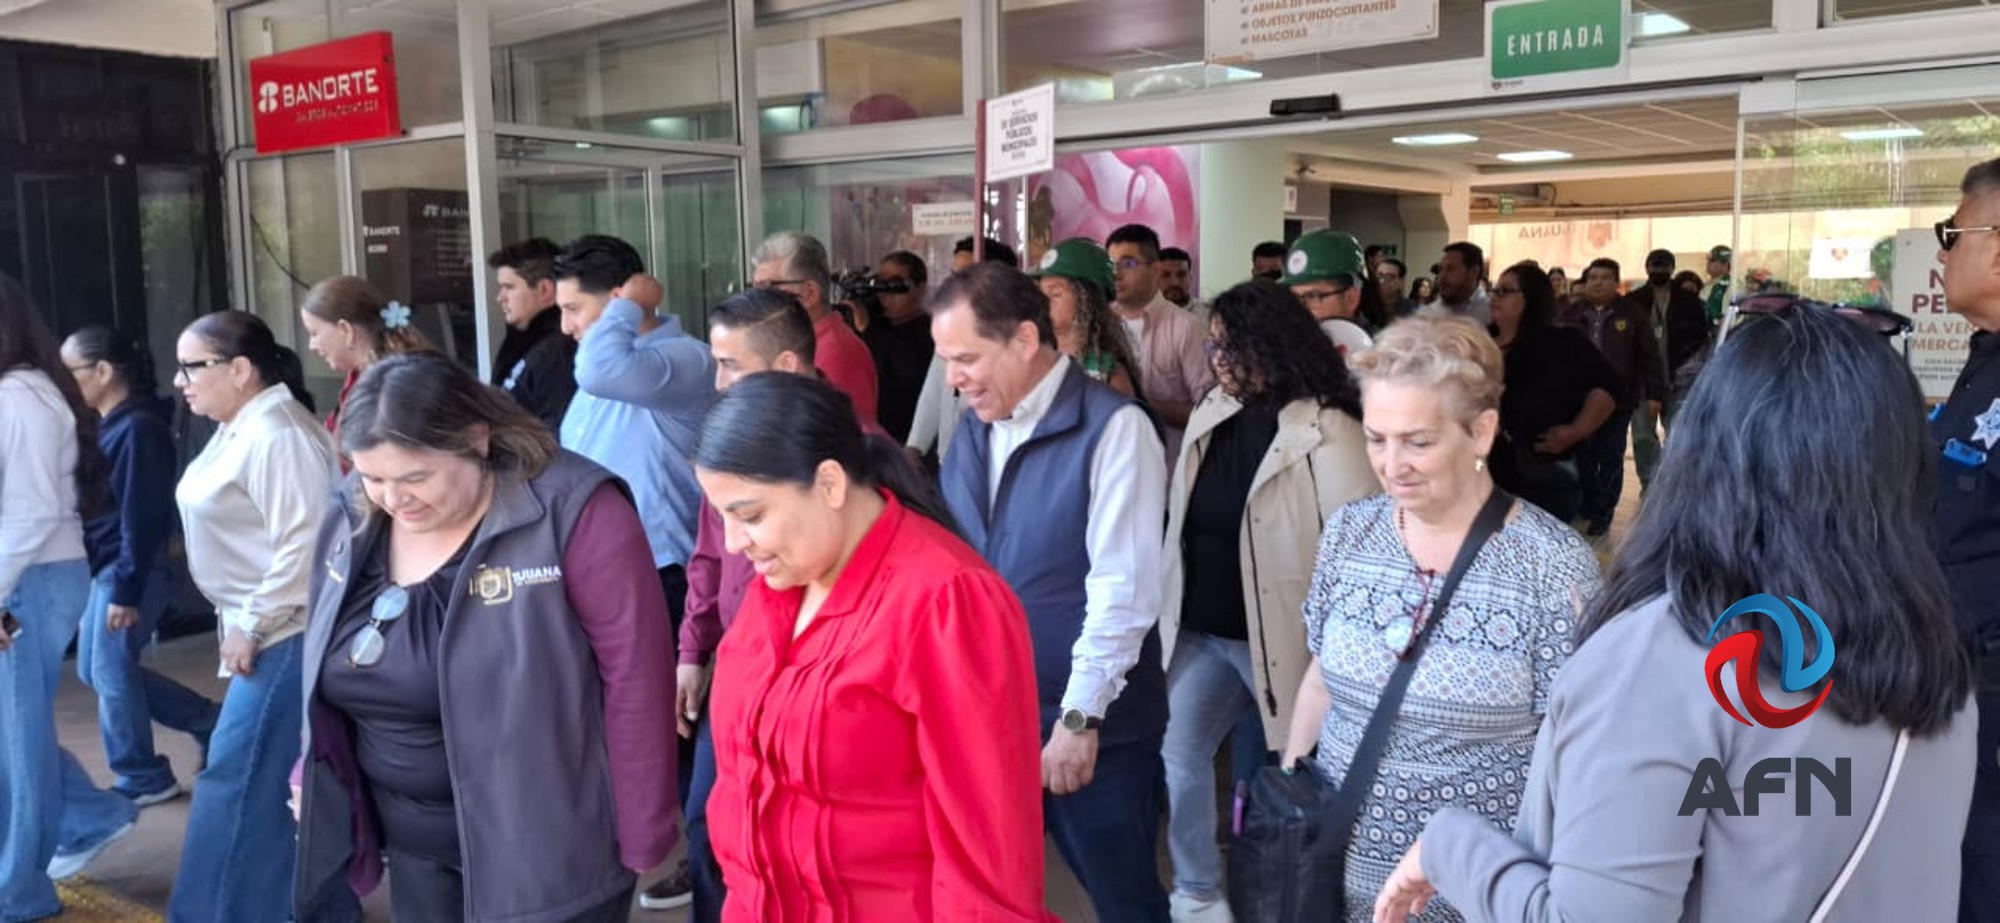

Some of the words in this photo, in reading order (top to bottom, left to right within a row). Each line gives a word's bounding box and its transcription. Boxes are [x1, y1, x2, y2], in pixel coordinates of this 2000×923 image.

[1251, 14, 1296, 28] OBJETOS
[1299, 1, 1396, 22] PUNZOCORTANTES
[1251, 27, 1308, 44] MASCOTAS
[1507, 24, 1604, 56] ENTRADA
[282, 68, 379, 108] BANORTE
[1917, 321, 1938, 335] LA
